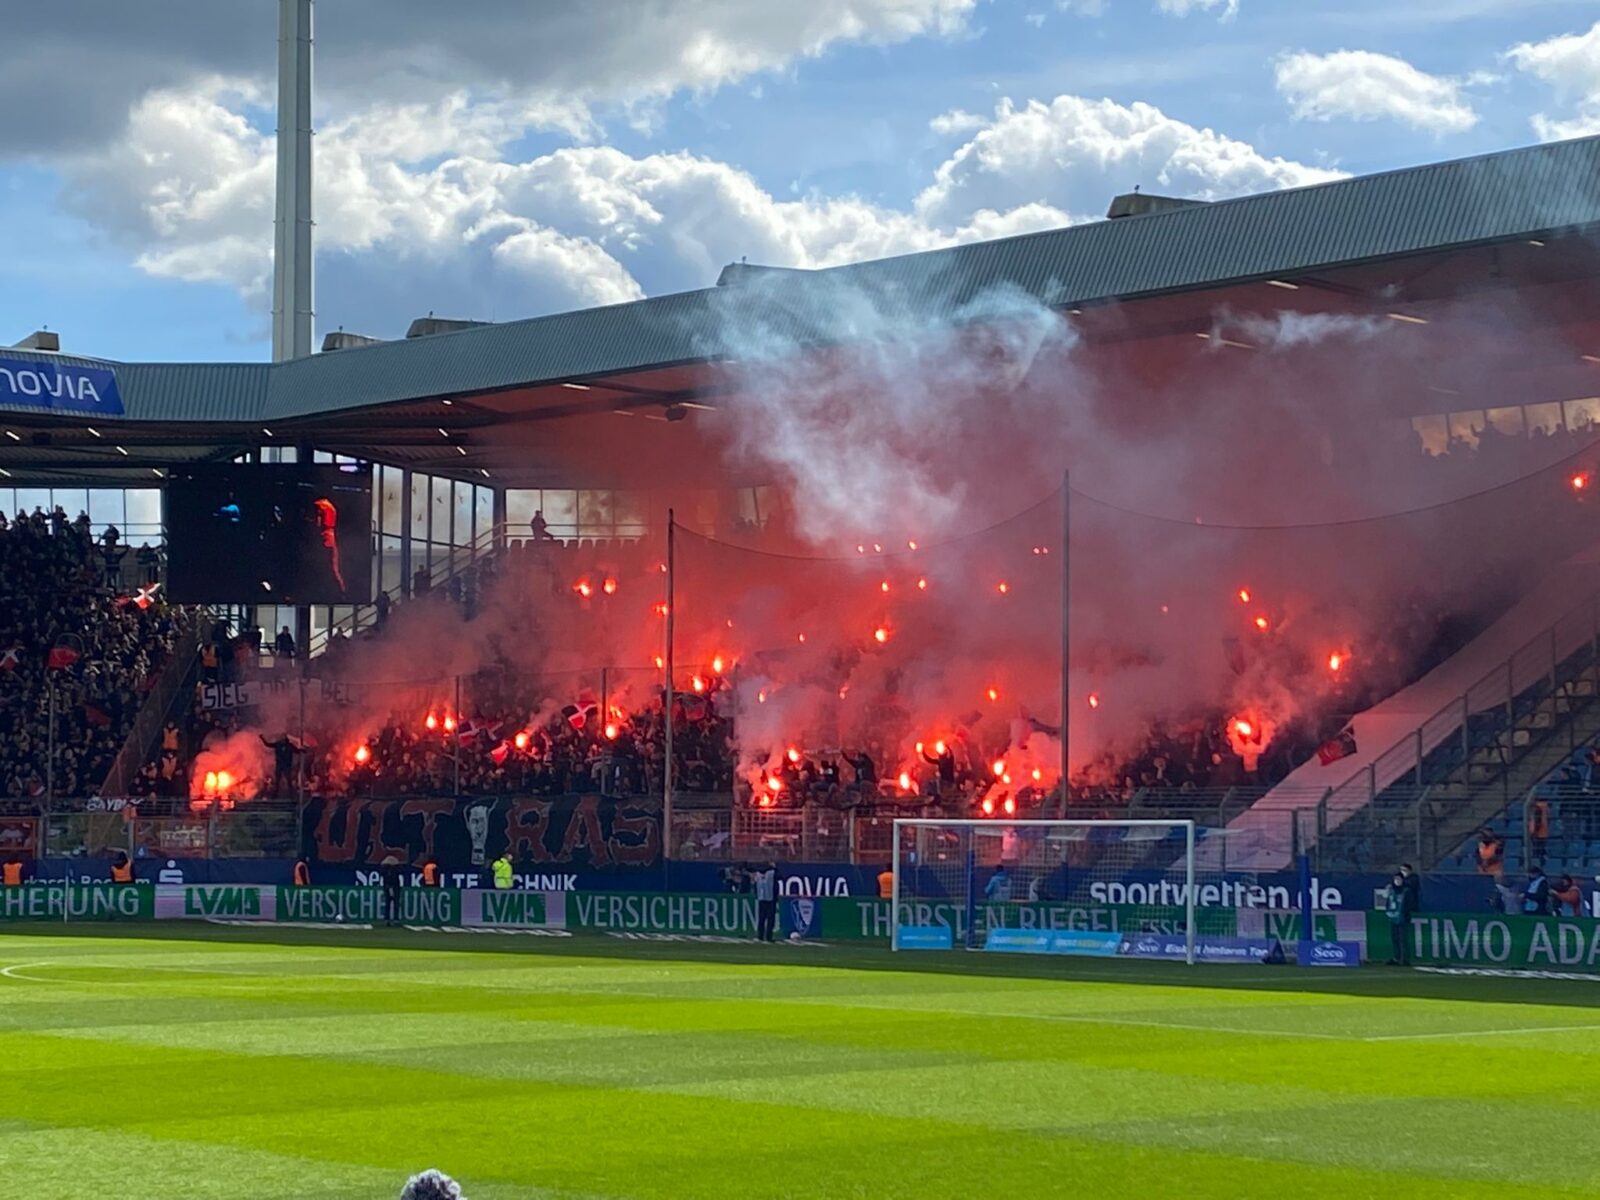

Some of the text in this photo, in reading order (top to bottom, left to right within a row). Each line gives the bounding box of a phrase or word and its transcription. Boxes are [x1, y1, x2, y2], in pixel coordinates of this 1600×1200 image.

[204, 683, 250, 708] SIEG
[0, 886, 140, 916] HERUNG
[284, 888, 452, 922] VERSICHEUNG
[575, 895, 780, 934] VERSICHERUN
[1410, 917, 1512, 962] TIMO
